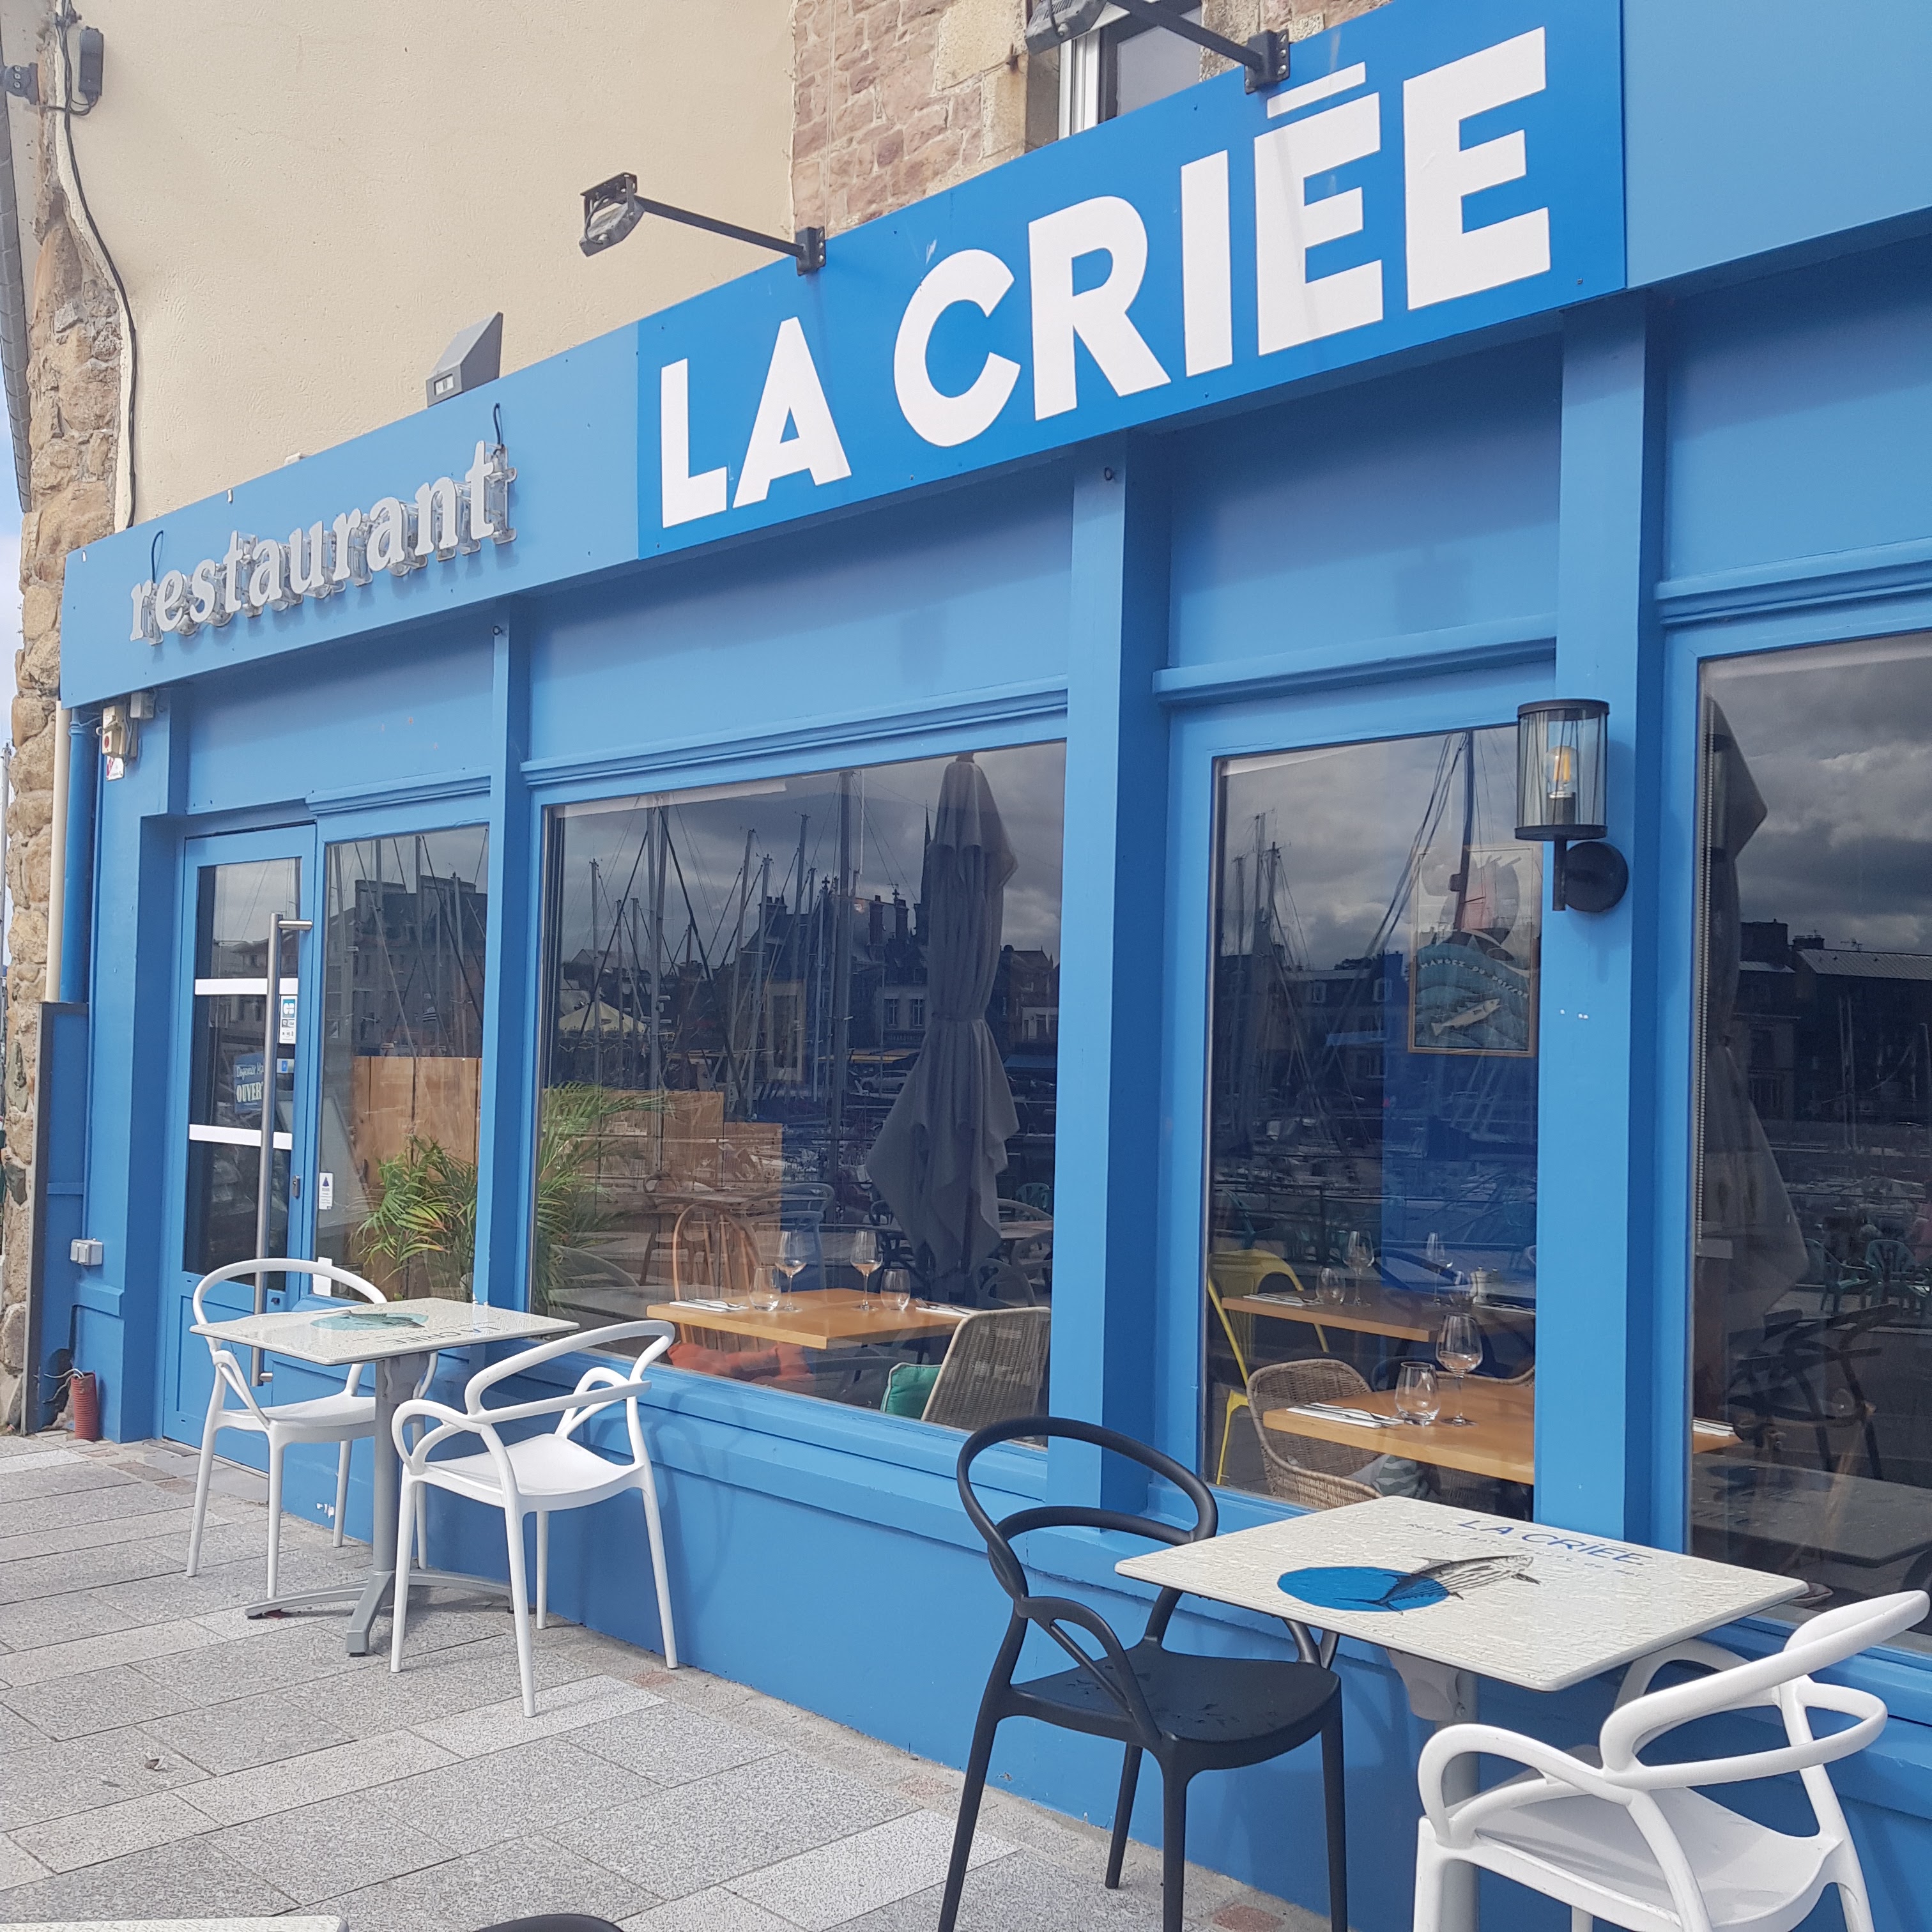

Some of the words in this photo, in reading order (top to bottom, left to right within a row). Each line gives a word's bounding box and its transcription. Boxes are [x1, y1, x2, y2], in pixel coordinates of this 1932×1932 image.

[660, 316, 852, 528] LA
[894, 26, 1552, 447] CRIÉE
[130, 440, 495, 642] restaurant
[1471, 965, 1485, 975] DU
[236, 1082, 264, 1103] OUVER
[1457, 1520, 1515, 1535] LA
